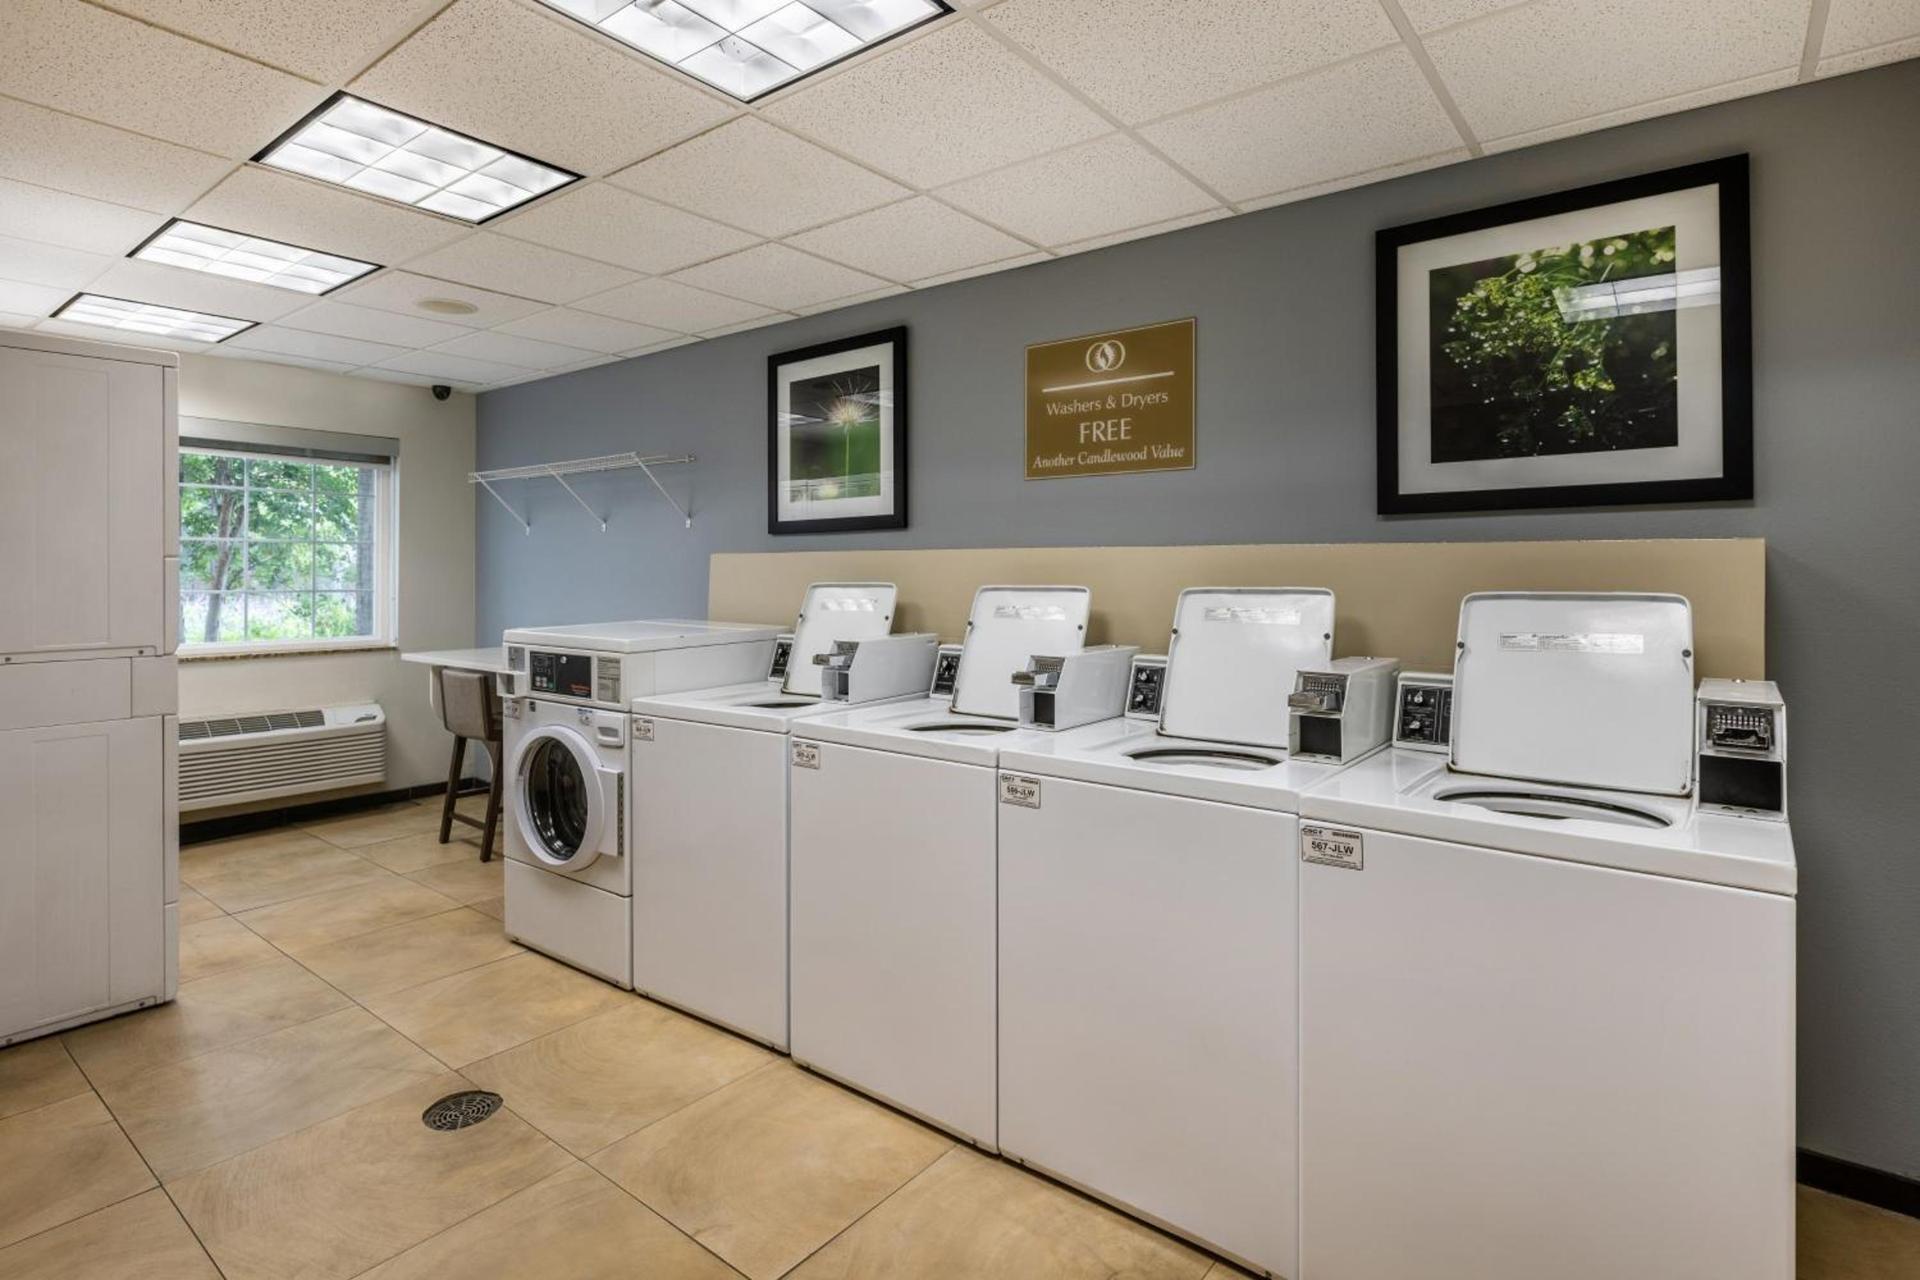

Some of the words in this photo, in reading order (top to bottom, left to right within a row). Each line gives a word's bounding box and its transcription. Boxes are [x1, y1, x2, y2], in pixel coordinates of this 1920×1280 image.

[1046, 398, 1102, 416] Washers
[1105, 395, 1117, 409] &
[1121, 391, 1169, 410] Dryers
[1079, 418, 1133, 444] FREE
[1033, 453, 1075, 469] Another
[1078, 446, 1148, 465] Candlewood
[1151, 443, 1185, 458] Value
[1311, 840, 1354, 855] 567-JLW
